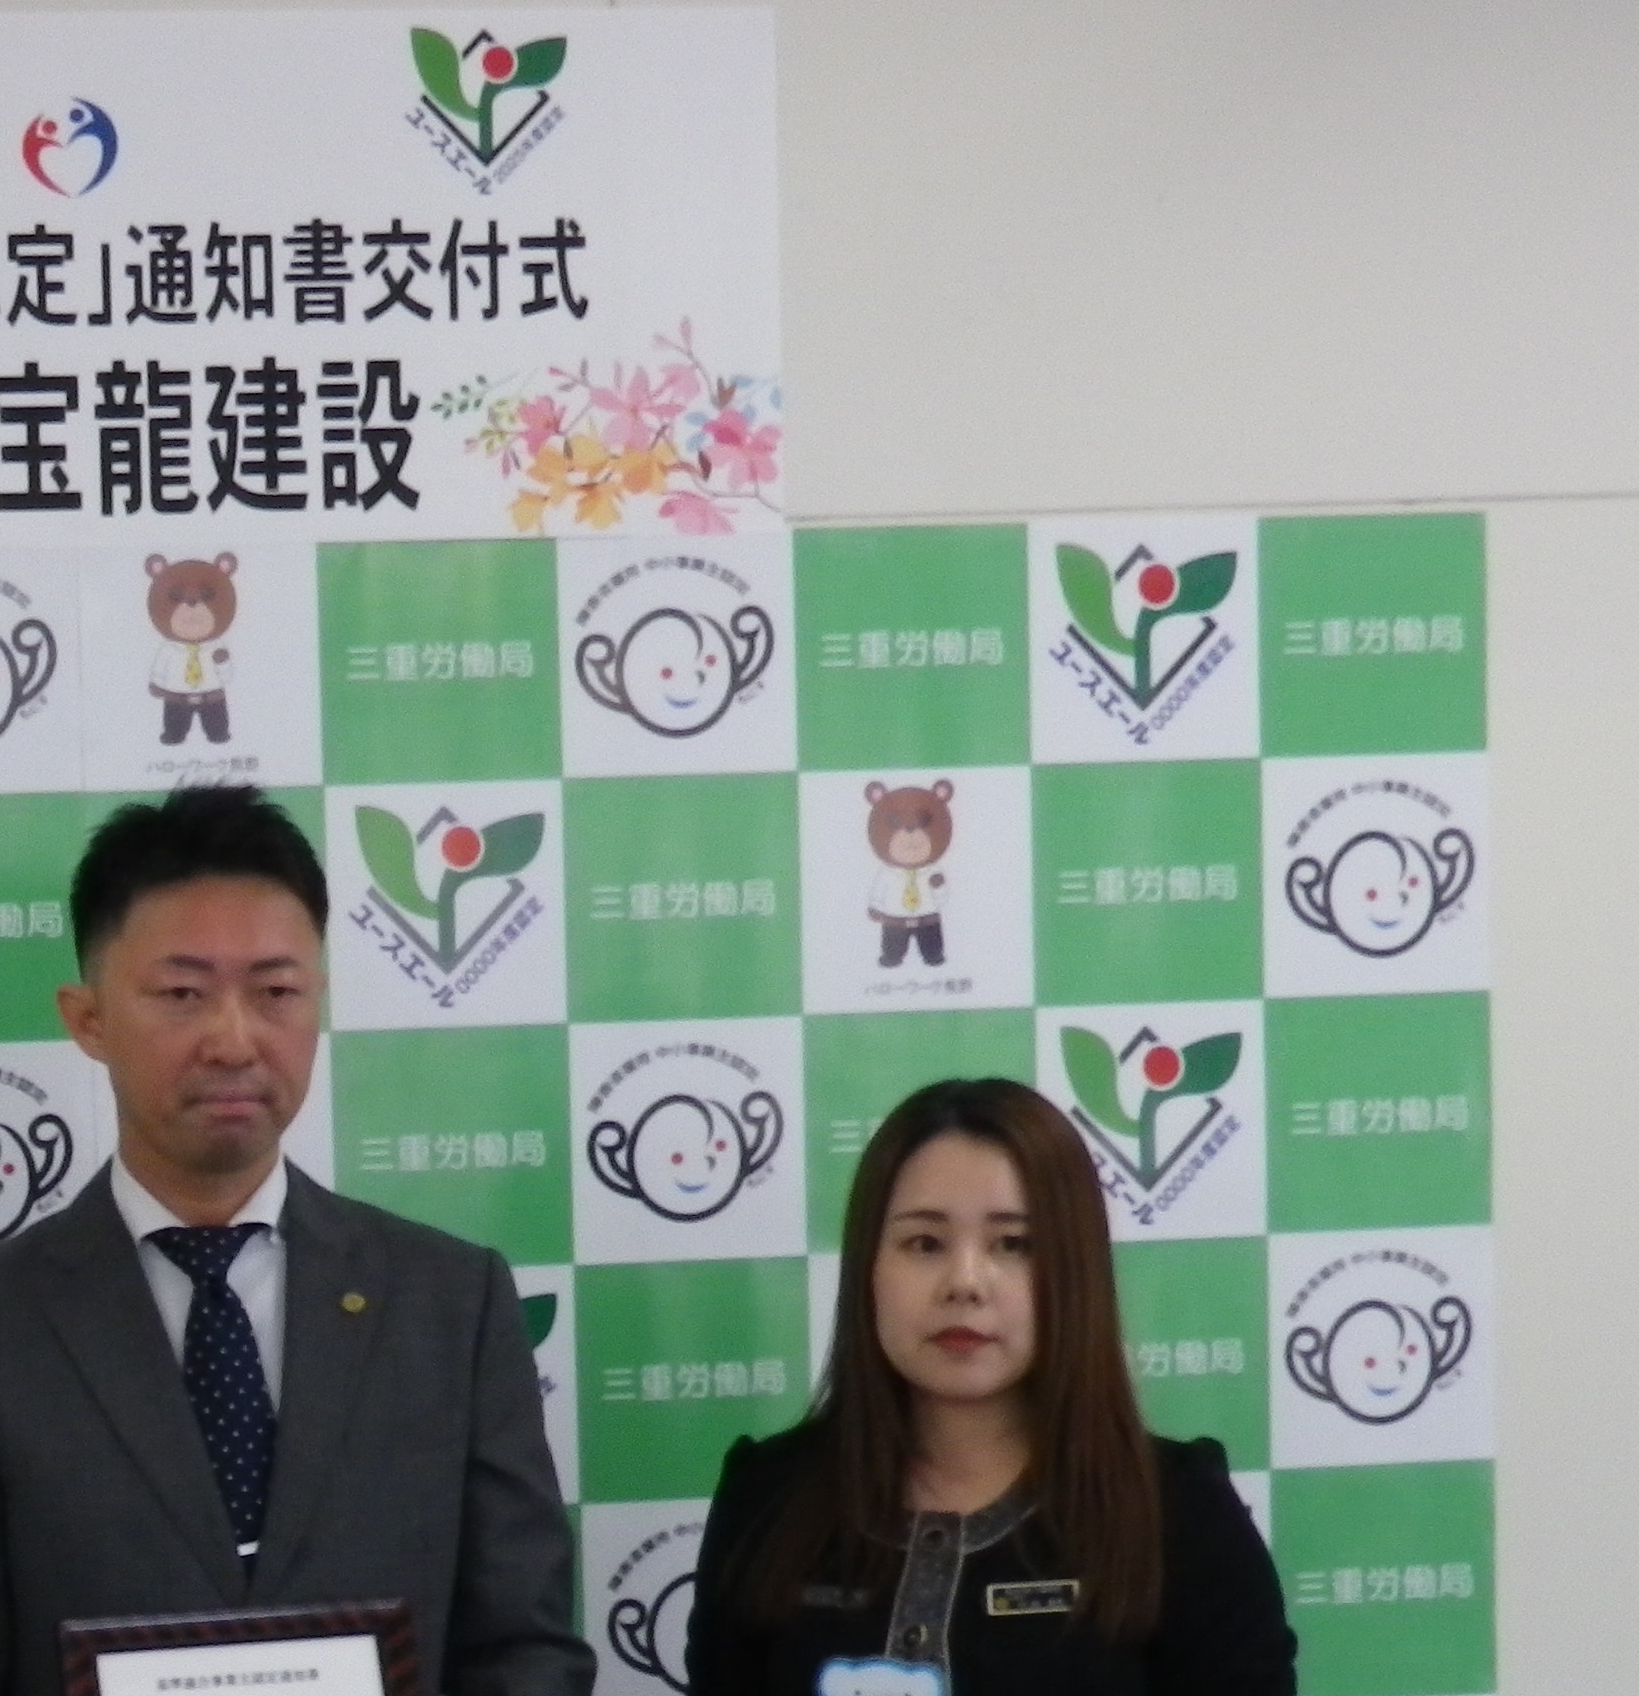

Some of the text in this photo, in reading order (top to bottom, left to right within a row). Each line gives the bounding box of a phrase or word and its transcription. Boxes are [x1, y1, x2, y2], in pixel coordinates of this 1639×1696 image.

[820, 628, 1004, 669] 三重労働局
[1284, 616, 1465, 656] 三重労働局
[346, 642, 534, 682] 三重労働局
[1049, 641, 1149, 745] ユースエール
[590, 879, 776, 920] 三重労働局
[1058, 864, 1238, 906] 三重労働局
[348, 905, 455, 1008] ユースエール
[1292, 1098, 1469, 1138] 三重労働局
[360, 1132, 546, 1172] 三重労働局
[603, 1359, 787, 1401] 三重労働局
[1295, 1564, 1474, 1604] 三重労働局
